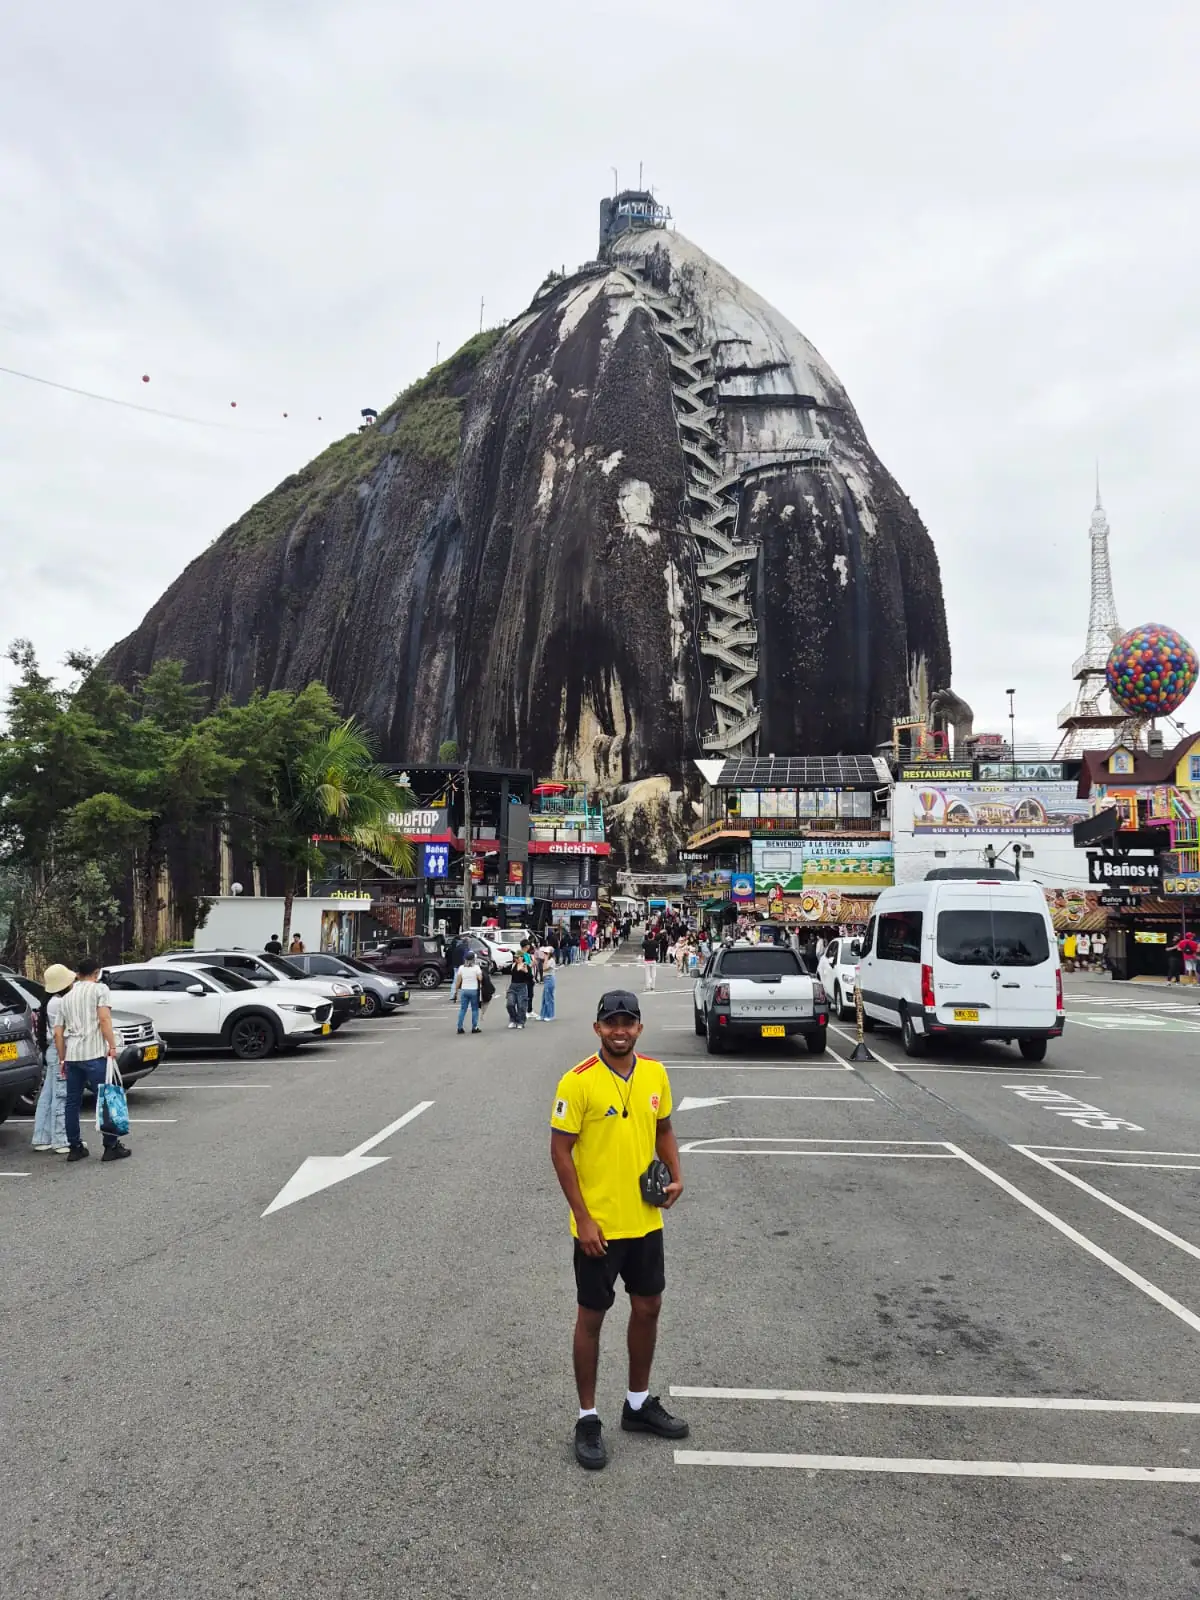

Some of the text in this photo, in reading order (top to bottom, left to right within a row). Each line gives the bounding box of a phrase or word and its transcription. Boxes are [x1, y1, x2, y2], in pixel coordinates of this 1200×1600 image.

[903, 770, 972, 779] RESTAURANTE
[387, 810, 440, 827] ROOFTOP
[766, 840, 805, 848] BIENVENIDOS
[1103, 862, 1146, 877] Baños
[741, 1005, 804, 1013] OROCH
